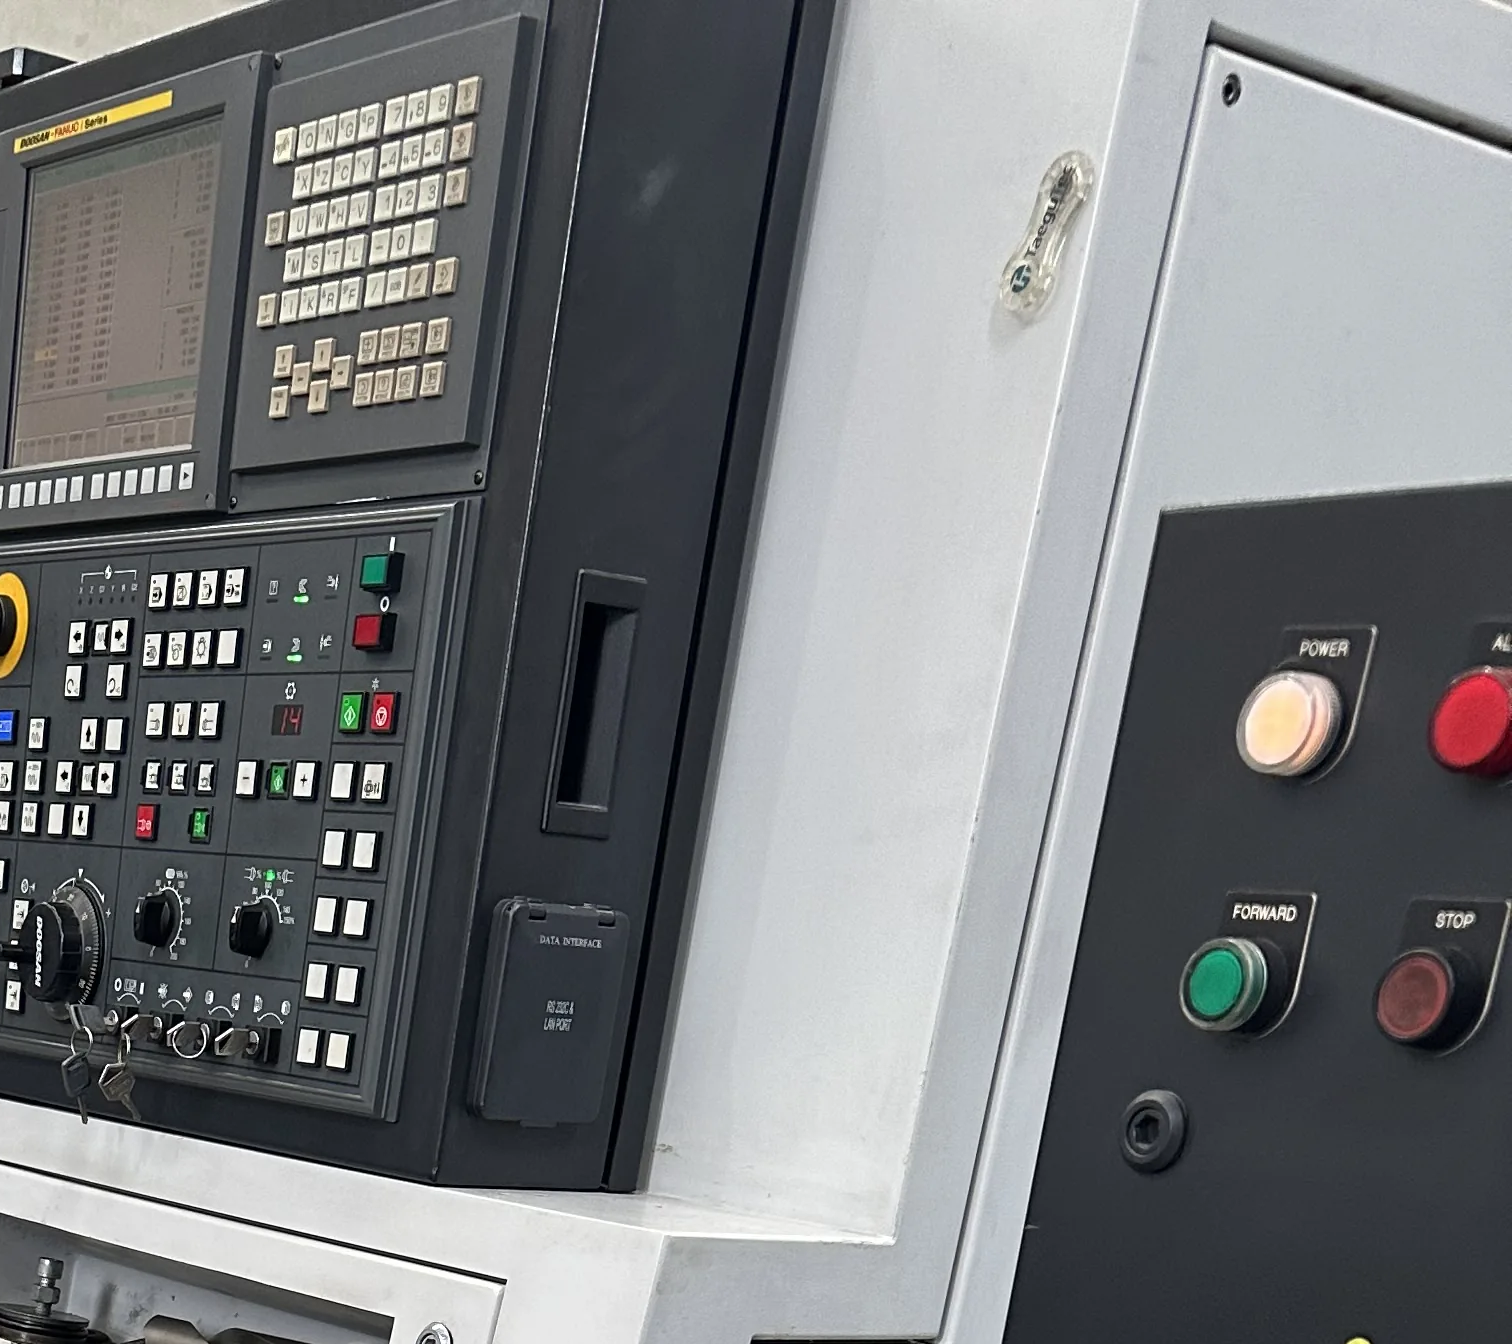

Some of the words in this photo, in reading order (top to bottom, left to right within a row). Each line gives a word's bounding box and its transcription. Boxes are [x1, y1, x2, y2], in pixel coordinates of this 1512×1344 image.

[1299, 639, 1350, 658] POWER
[280, 707, 302, 736] 14
[1232, 904, 1298, 923] FORWARD
[1435, 911, 1476, 929] STOP
[34, 915, 43, 988] DOOSAN
[539, 934, 561, 946] DATA
[562, 936, 602, 950] INTERFACE
[556, 1018, 574, 1032] PORT
